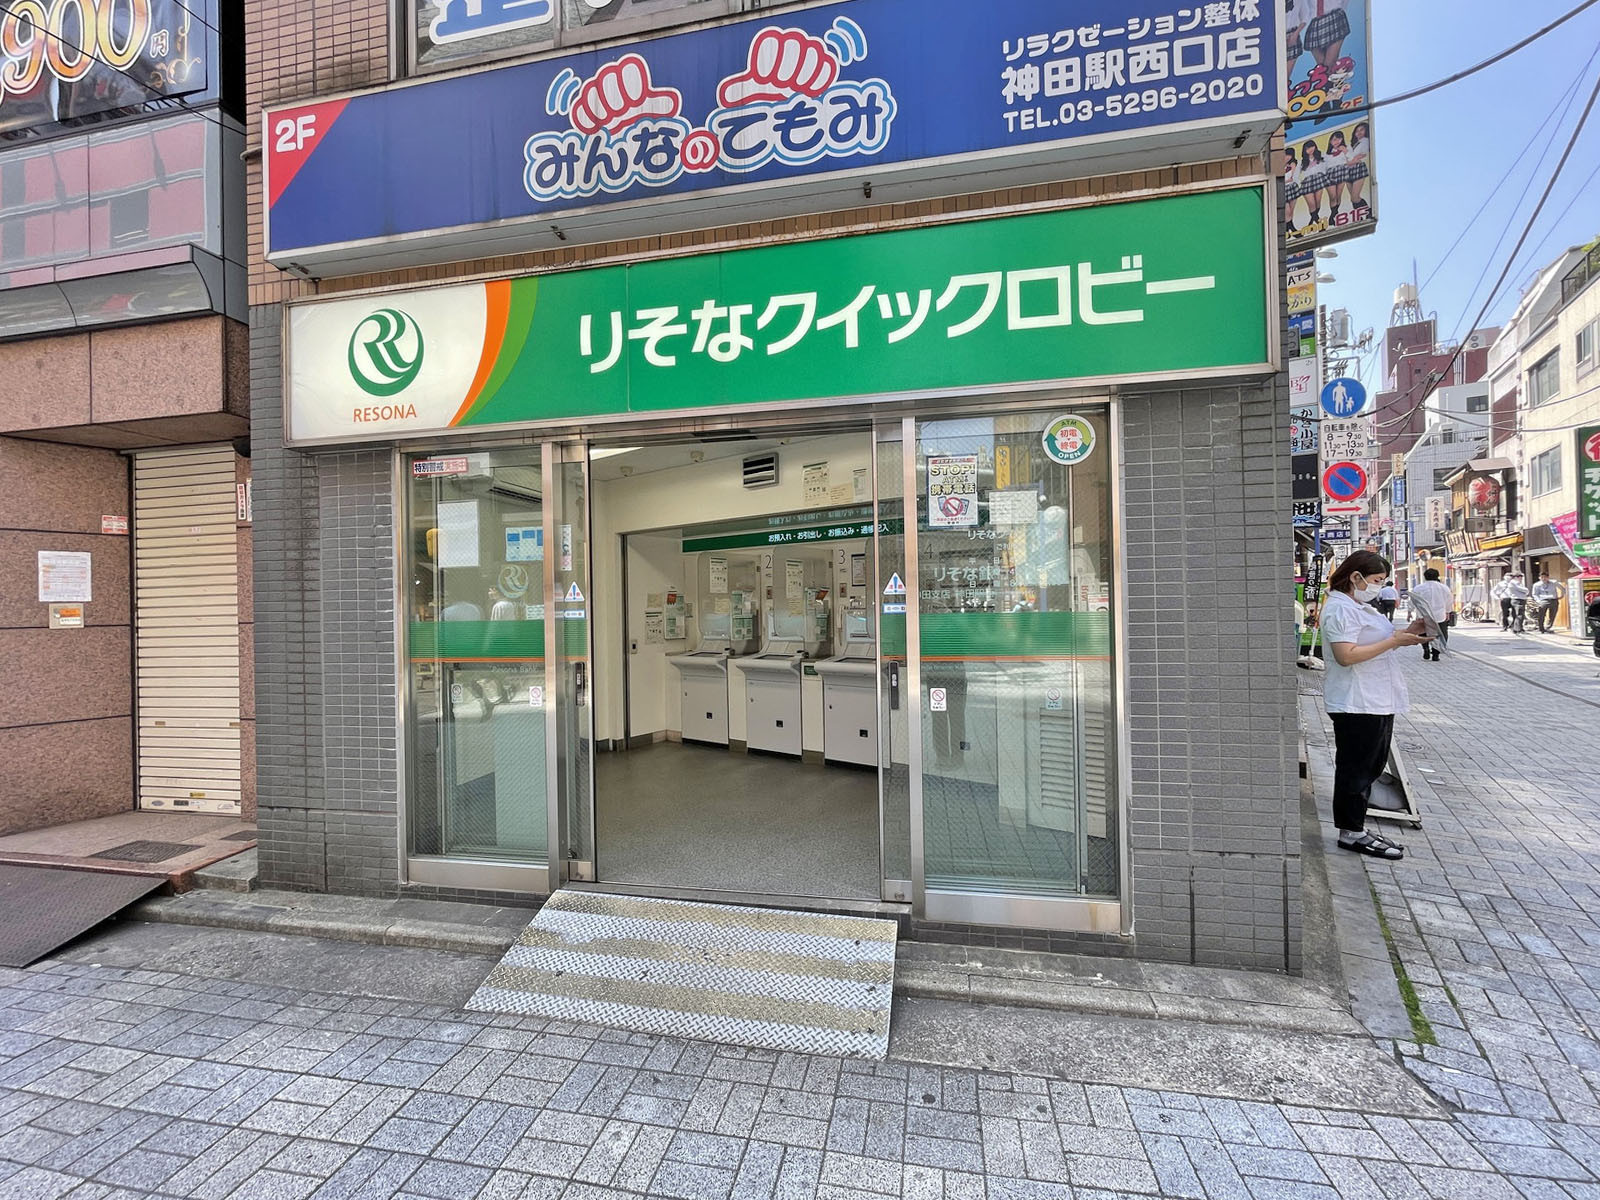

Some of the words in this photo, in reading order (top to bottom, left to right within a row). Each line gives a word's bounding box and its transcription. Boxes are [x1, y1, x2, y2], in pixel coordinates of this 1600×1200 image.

[1002, 0, 1260, 62] リラクゼーション整体
[1001, 27, 1262, 104] 神田駅西口店
[1003, 73, 1264, 133] TEL.03-5296-2020
[275, 114, 316, 152] 2F
[532, 90, 885, 192] みんなのてもみ
[1335, 206, 1369, 227] B1F
[579, 254, 1216, 375] りそなクイックロビー
[353, 403, 417, 424] RESONA
[1057, 450, 1081, 459] OPEN
[931, 463, 976, 477] STOP!
[765, 555, 773, 569] 2
[838, 549, 847, 565] 3
